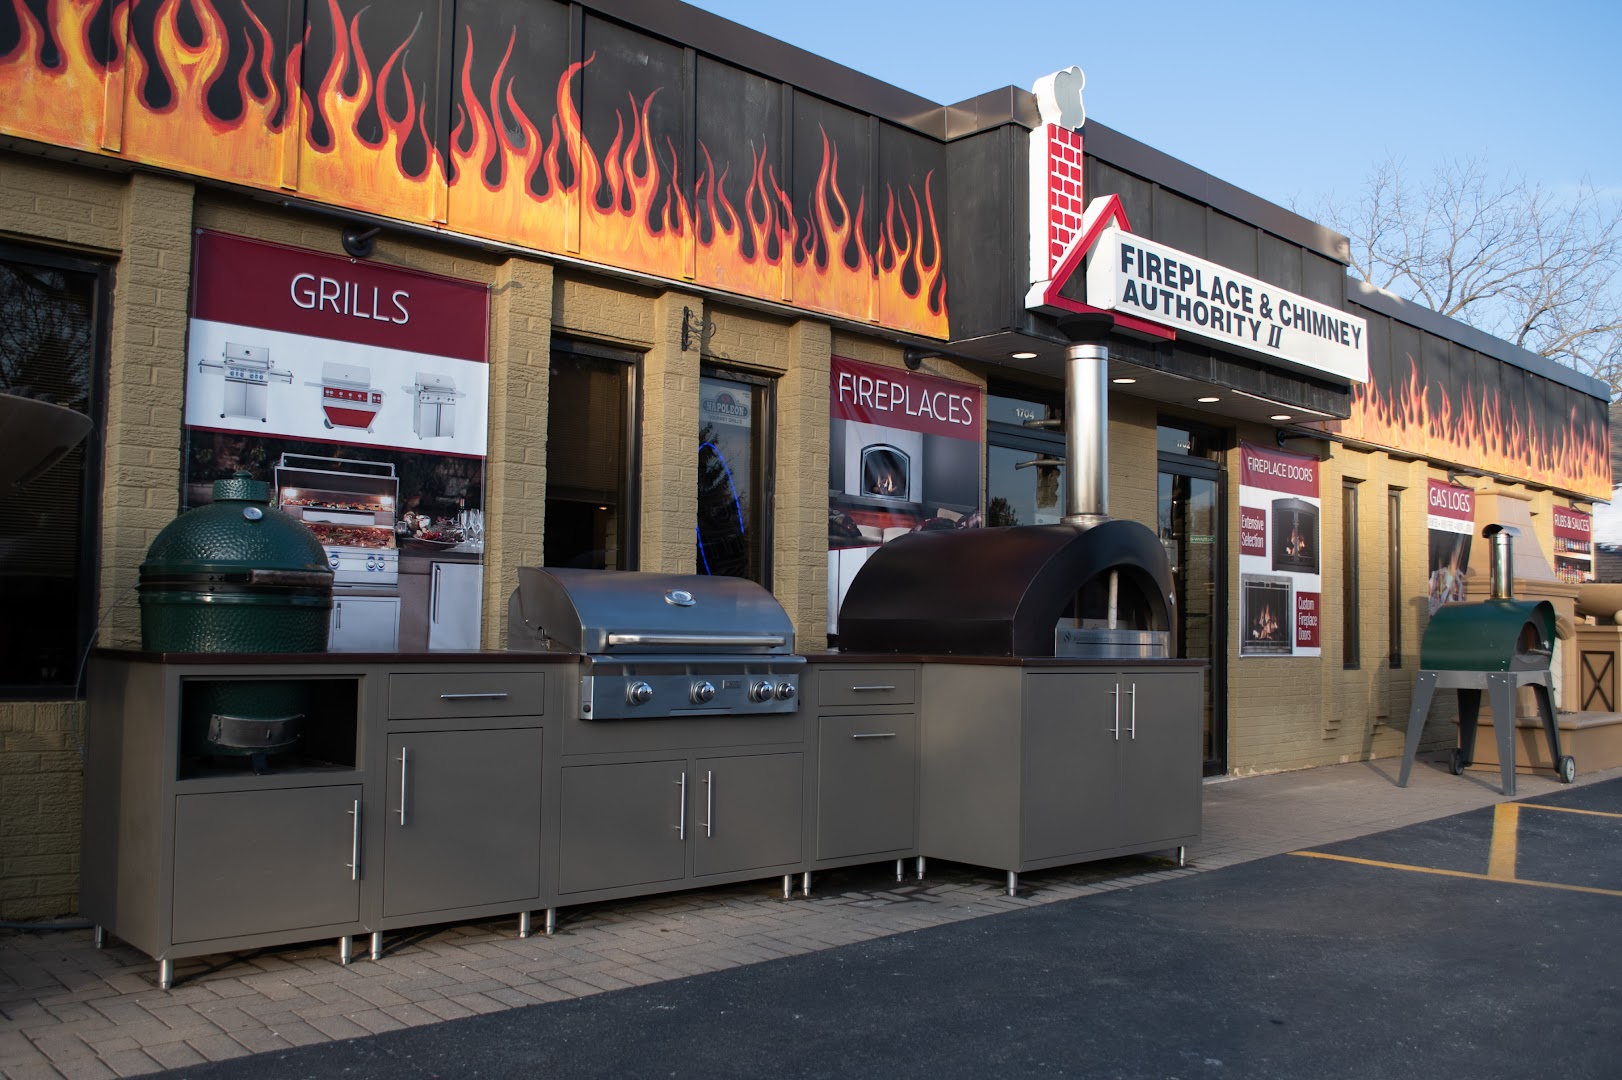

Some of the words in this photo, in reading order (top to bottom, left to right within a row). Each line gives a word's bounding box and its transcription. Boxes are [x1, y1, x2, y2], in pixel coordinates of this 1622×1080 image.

[290, 272, 410, 325] GRILLS
[1121, 243, 1254, 314] FIREPLACE
[1259, 293, 1273, 320] &
[1279, 299, 1362, 350] CHIMNEY
[1123, 279, 1261, 342] AUTHORITY
[1267, 323, 1283, 349] II
[838, 372, 973, 426] FIREPLACES
[706, 401, 744, 416] NAPOLEON
[1016, 407, 1034, 419] 1704
[1176, 440, 1191, 449] 1702
[1248, 456, 1287, 478] FIREPLACE
[1288, 465, 1313, 482] DOORS
[1429, 487, 1446, 508] GAS
[1448, 490, 1470, 513] LOGS
[1241, 514, 1264, 531] Extensive
[1554, 513, 1567, 528] RUBS
[1566, 517, 1572, 528] &
[1572, 517, 1590, 532] SAUCES
[1241, 532, 1264, 548] Selection
[1298, 596, 1315, 610] Custom
[1298, 612, 1318, 628] Fireplace
[1298, 627, 1311, 640] Doors
